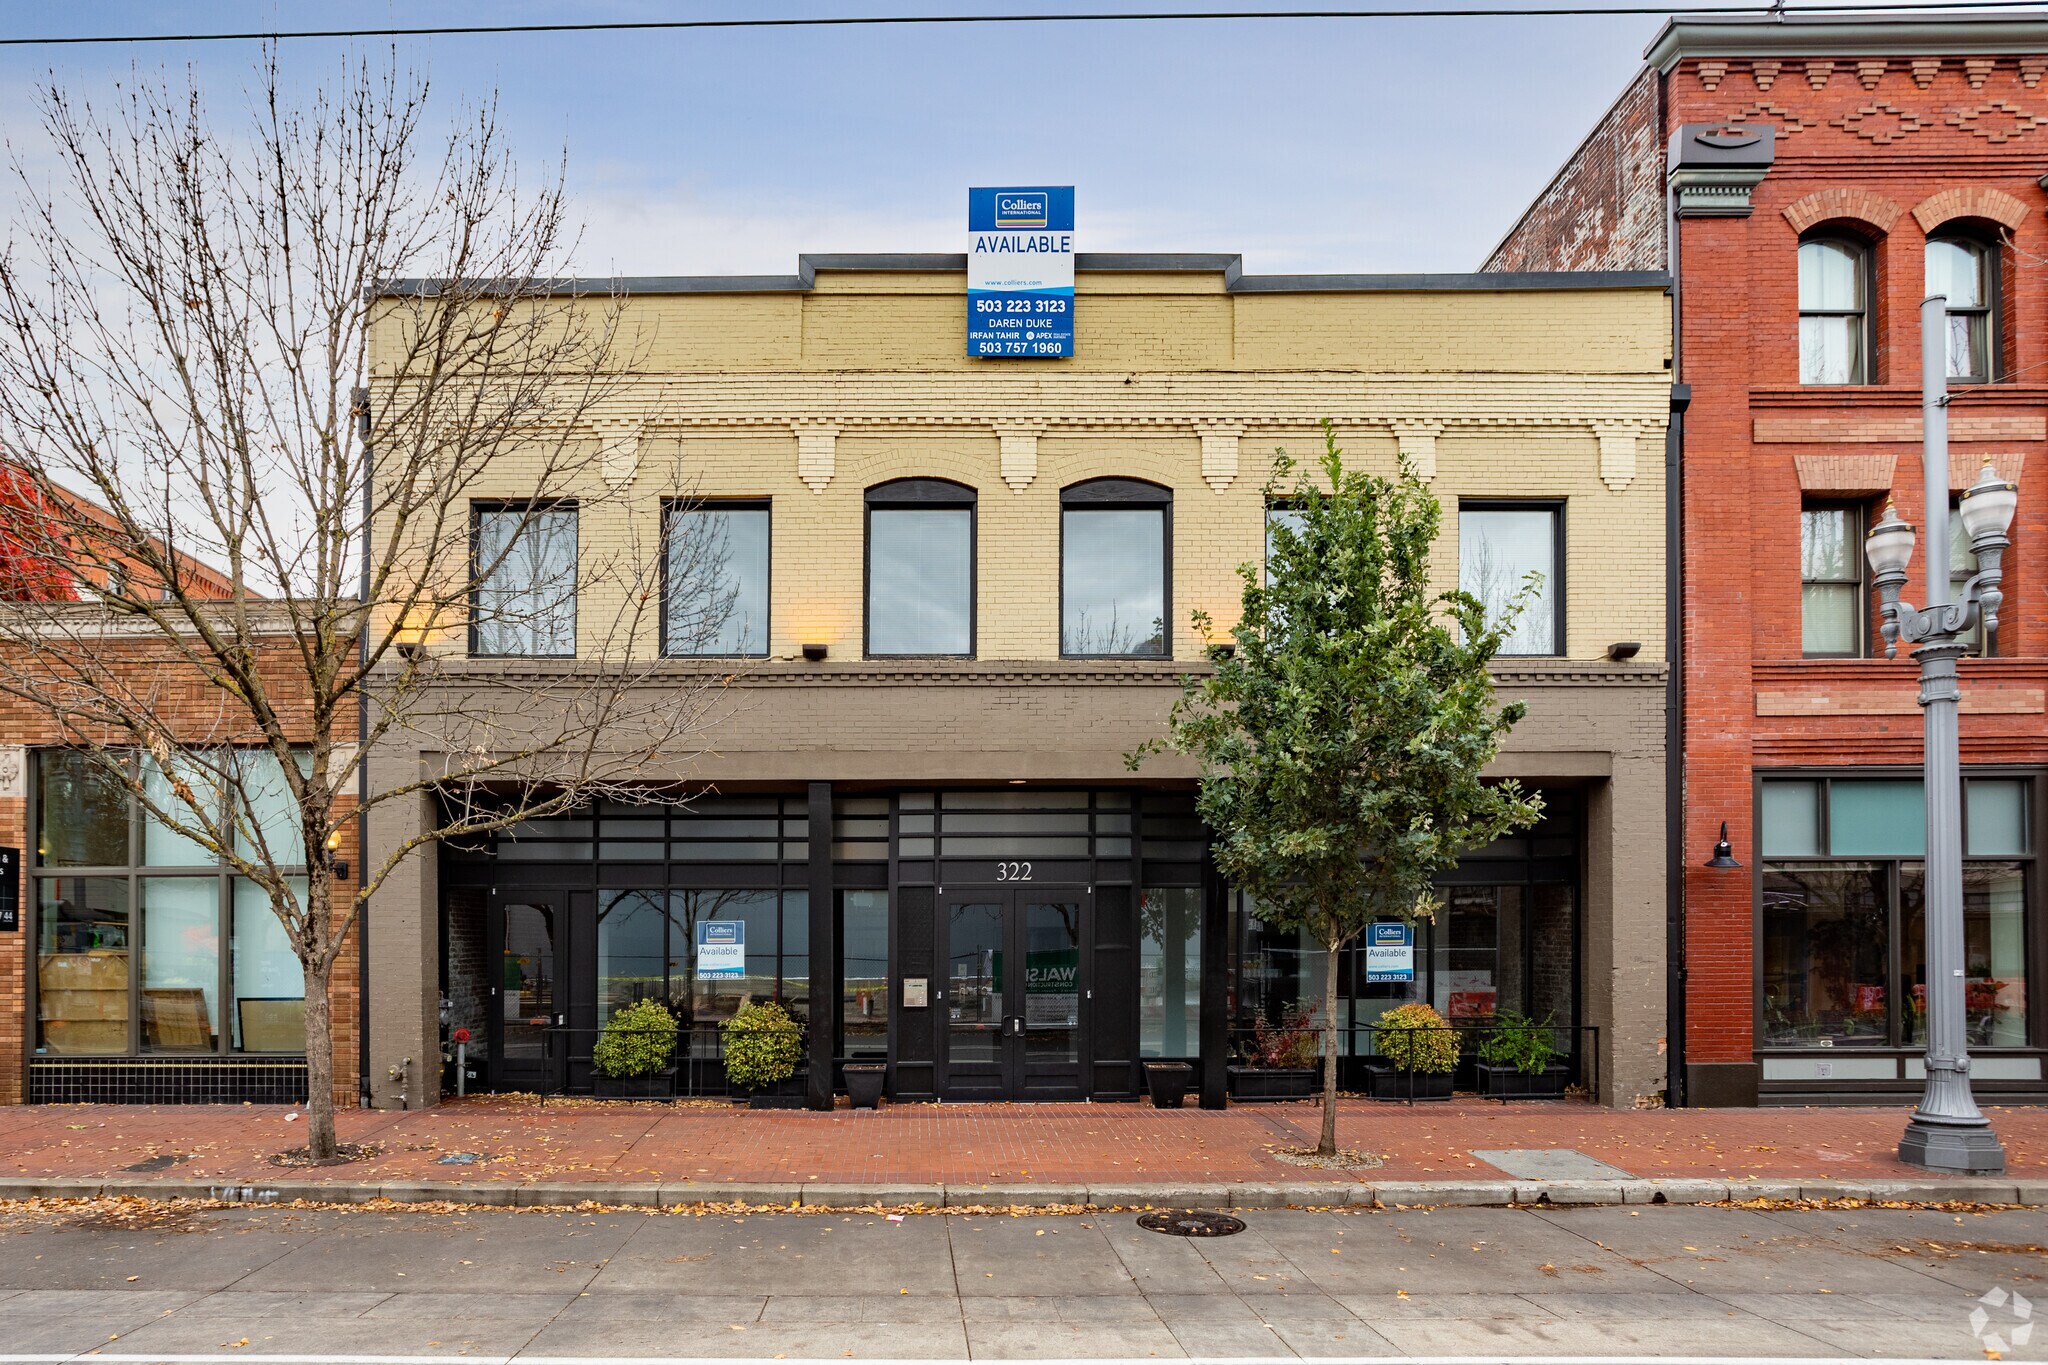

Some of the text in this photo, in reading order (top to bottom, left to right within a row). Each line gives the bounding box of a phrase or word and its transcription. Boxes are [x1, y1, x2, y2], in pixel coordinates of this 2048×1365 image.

[1001, 199, 1042, 210] Colliers
[975, 236, 1070, 253] AVAILABLE
[976, 300, 1066, 313] 503 223 3123
[989, 318, 1053, 328] DAREN DUKE
[970, 331, 993, 339] IRFAN
[995, 331, 1020, 339] TAHIR
[979, 342, 1062, 353] 503 757 1960
[996, 862, 1032, 881] 322
[700, 947, 738, 955] Available
[1369, 949, 1406, 957] Available
